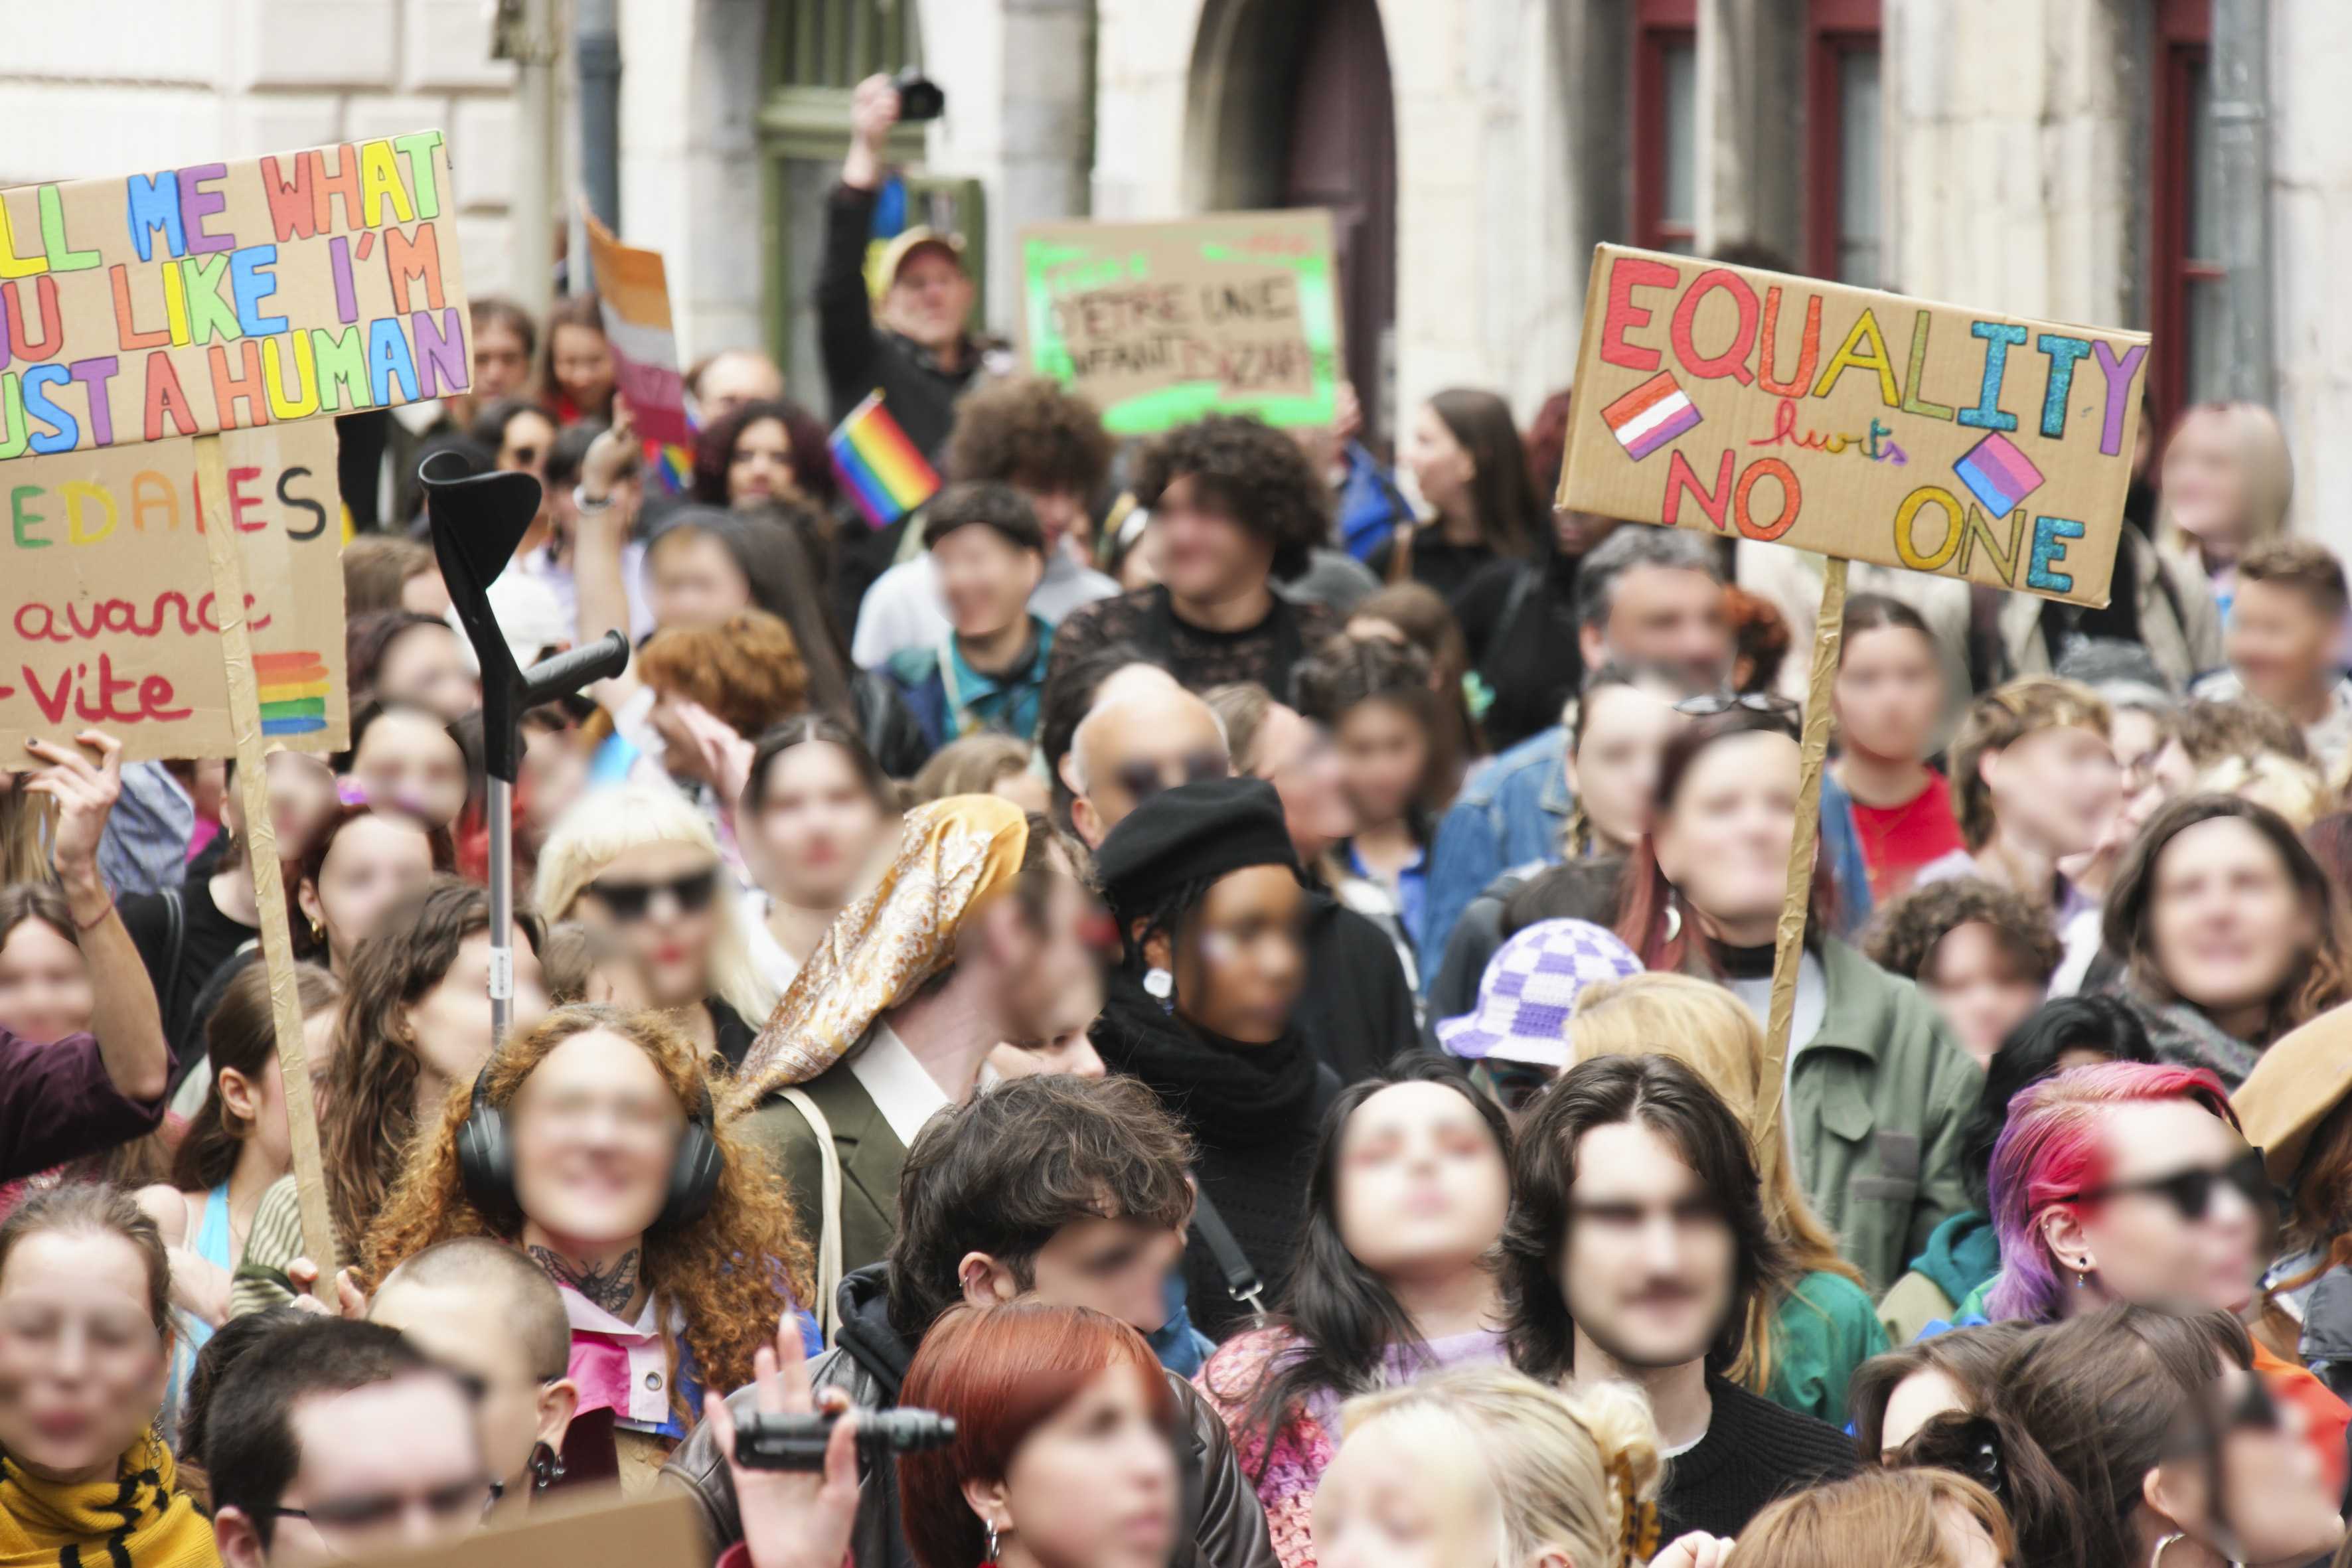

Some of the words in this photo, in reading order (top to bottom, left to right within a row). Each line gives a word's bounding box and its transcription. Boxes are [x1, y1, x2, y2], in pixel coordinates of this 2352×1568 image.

[127, 170, 235, 263] ME
[260, 131, 442, 243] WHAT
[109, 243, 288, 352] LIKE
[329, 222, 445, 325] I'M
[144, 351, 198, 441] A
[207, 307, 470, 431] HUMAN
[1601, 258, 2148, 457] EQUALITY
[1748, 397, 1909, 467] hurts
[1662, 449, 1802, 542] NO
[1894, 485, 2085, 593] ONE
